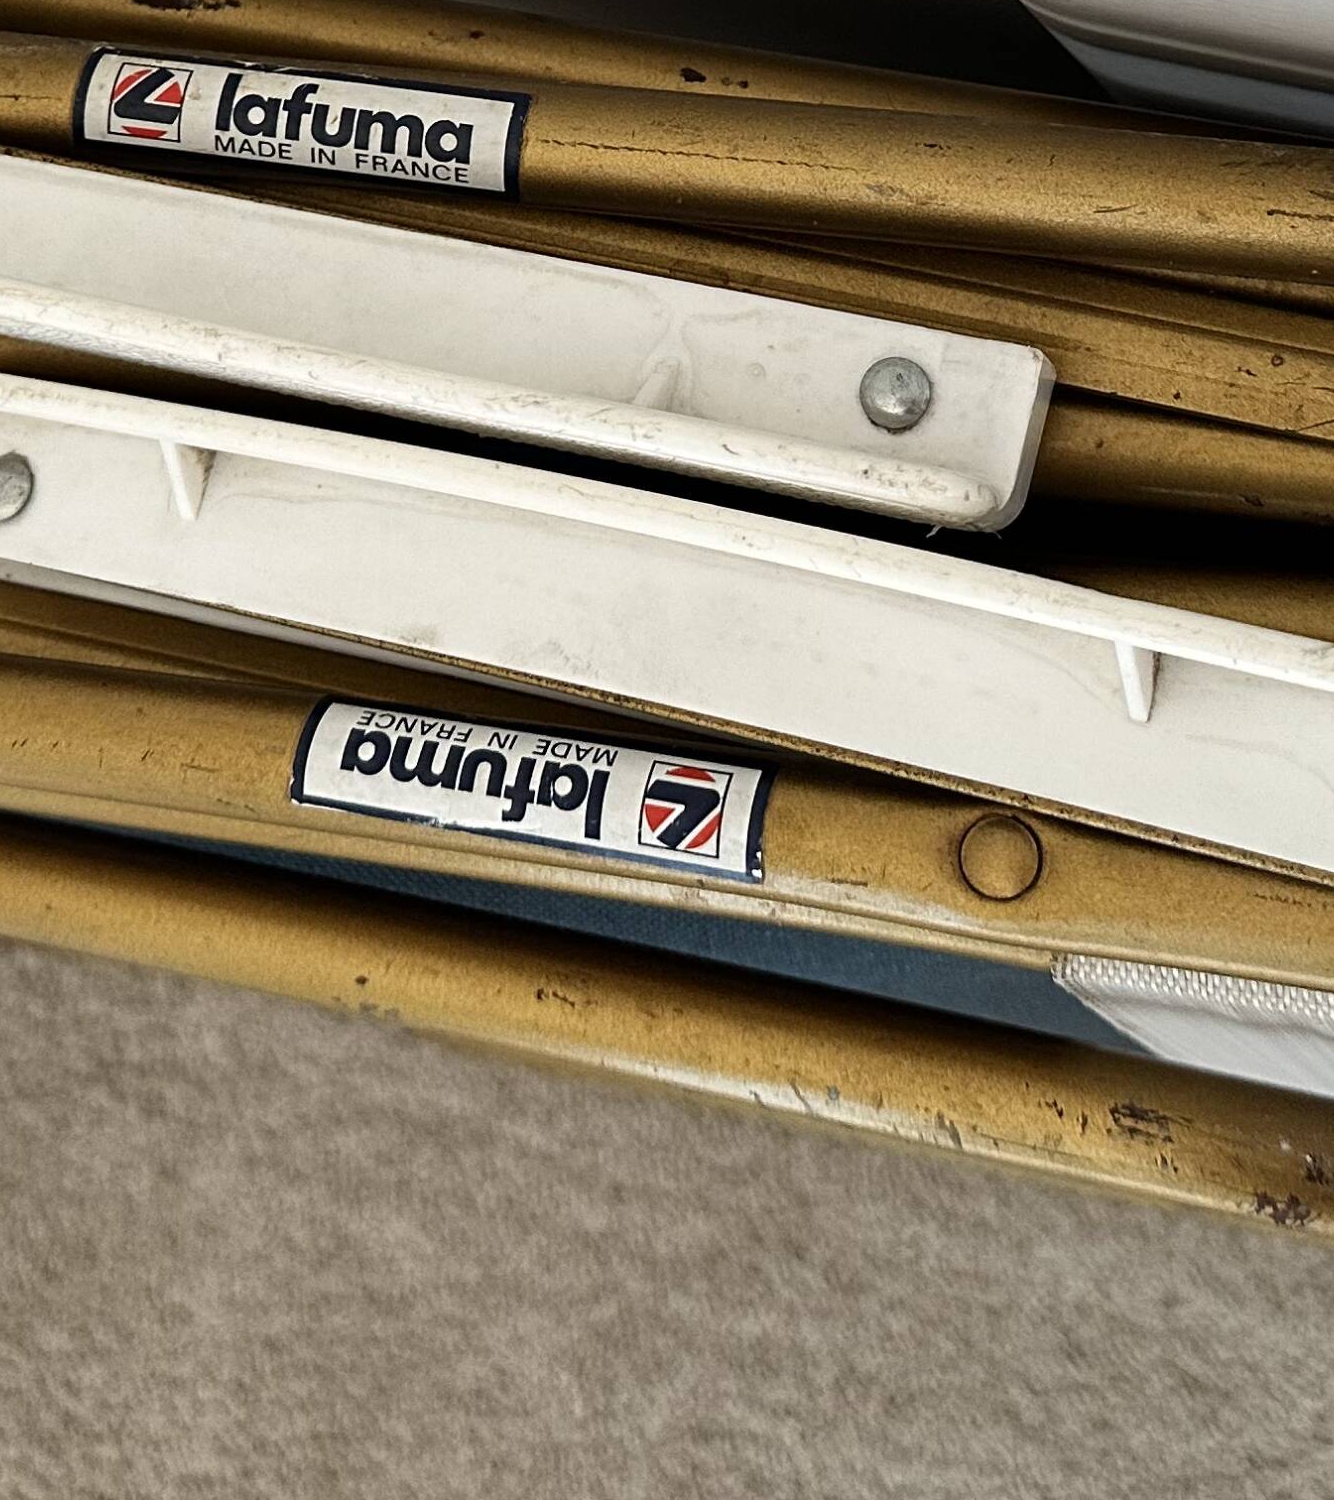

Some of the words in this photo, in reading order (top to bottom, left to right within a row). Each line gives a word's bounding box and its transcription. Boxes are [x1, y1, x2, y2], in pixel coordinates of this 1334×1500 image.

[213, 71, 475, 167] lafuma
[214, 134, 294, 162] MADE
[310, 147, 337, 167] IN
[355, 152, 471, 185] FRANCE
[355, 709, 475, 744] FRANCE
[487, 731, 520, 752] IN
[530, 737, 620, 767] MADE
[338, 726, 612, 842] lafuma
